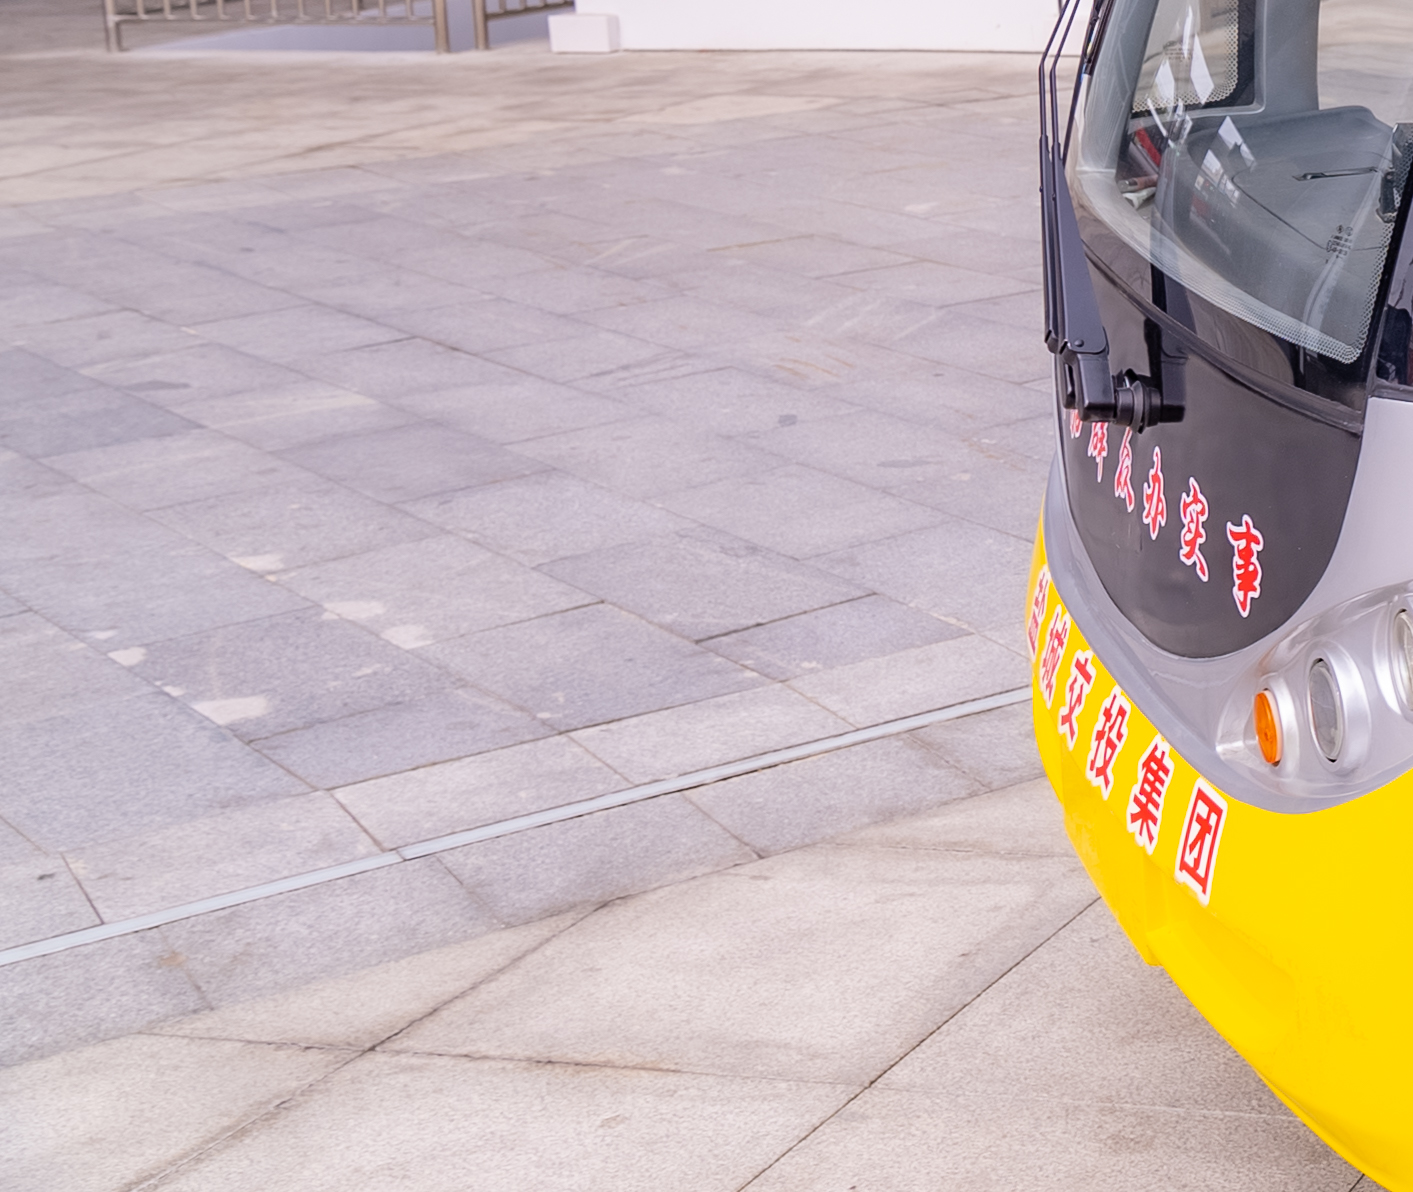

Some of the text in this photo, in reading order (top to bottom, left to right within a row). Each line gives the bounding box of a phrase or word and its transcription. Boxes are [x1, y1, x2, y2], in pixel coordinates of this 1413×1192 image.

[1027, 564, 1229, 906] 盐城交投集团
